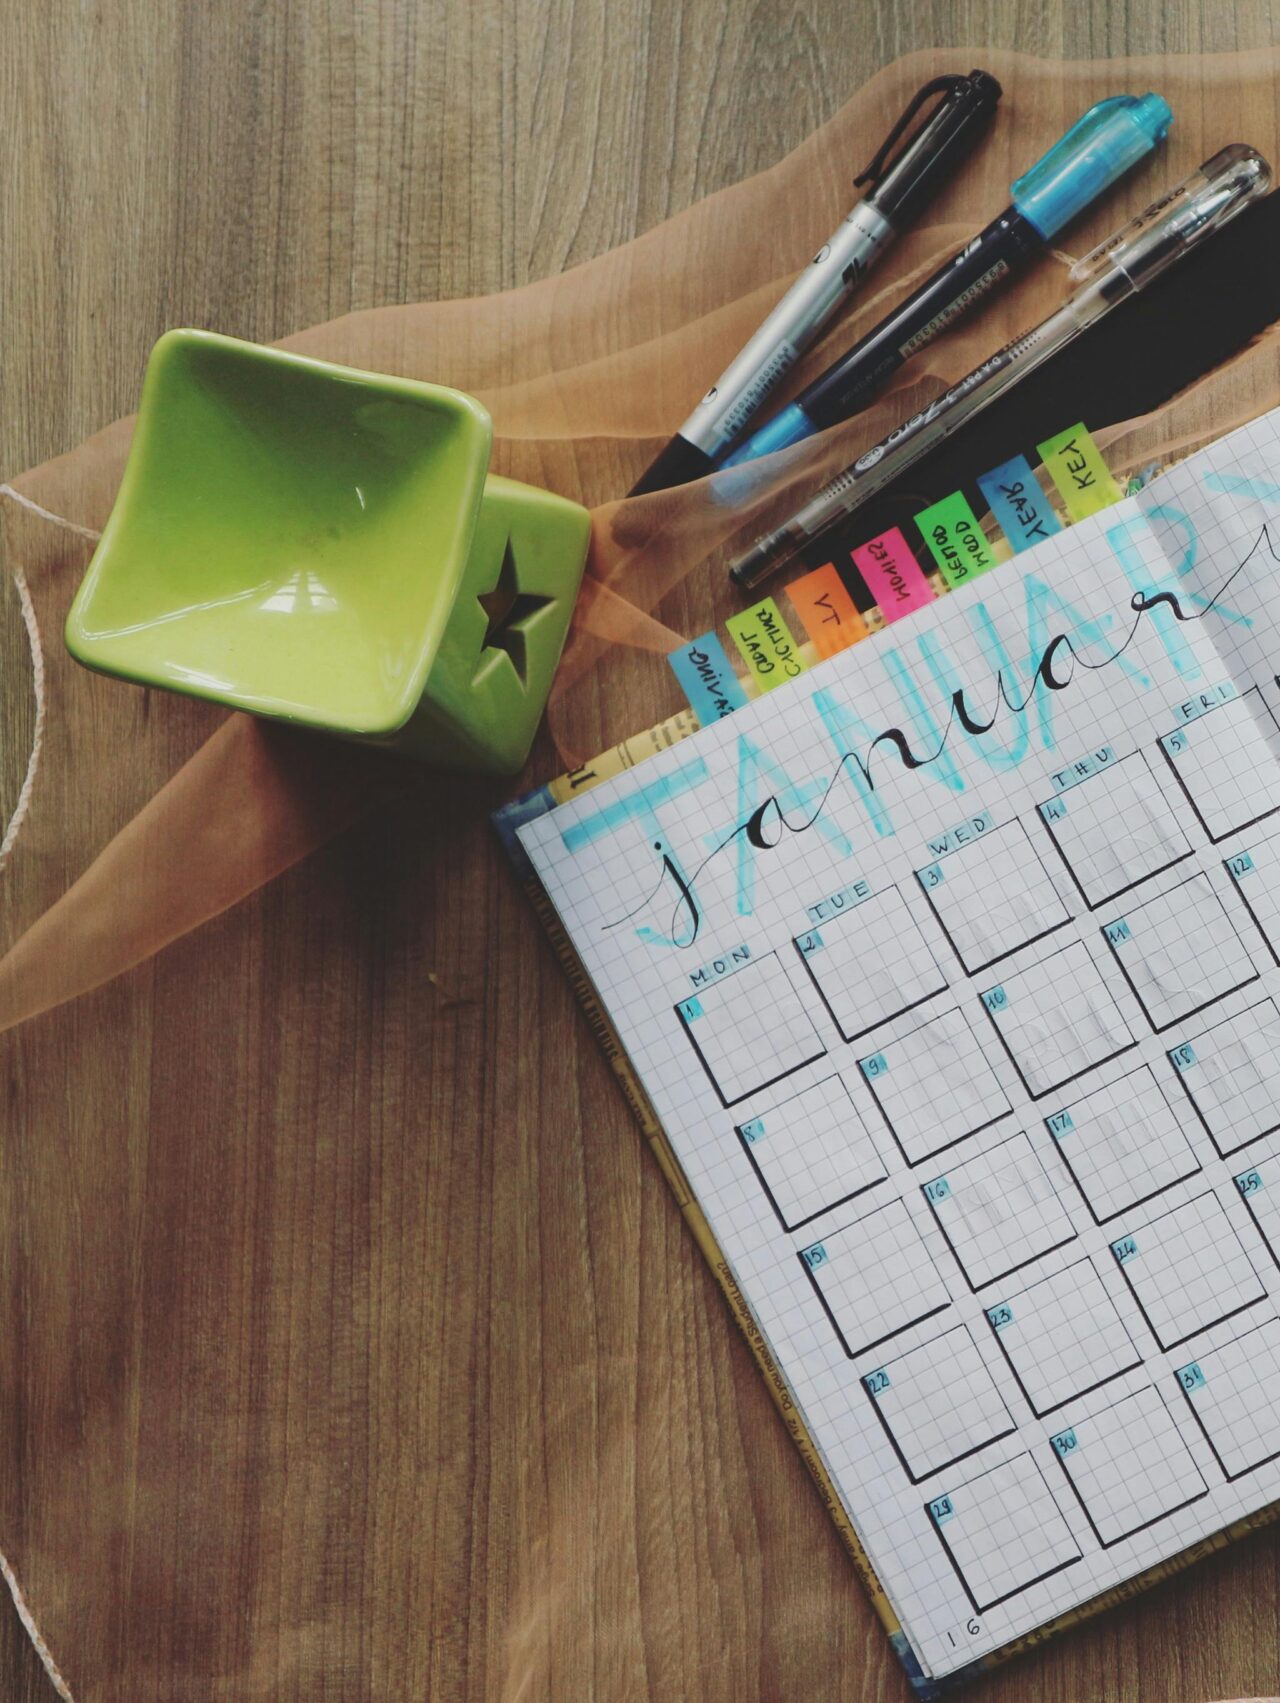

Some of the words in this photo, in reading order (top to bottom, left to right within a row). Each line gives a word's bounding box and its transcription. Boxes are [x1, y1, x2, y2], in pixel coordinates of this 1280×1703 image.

[1181, 686, 1228, 718] FRI
[1171, 736, 1182, 752] 5
[1051, 748, 1110, 788] THU
[1047, 805, 1060, 819] 4
[931, 819, 986, 854] WED
[1233, 858, 1250, 876] 12
[929, 871, 939, 887] 3
[808, 882, 867, 920] TUE
[1108, 927, 1126, 943] 11
[804, 937, 816, 952] 2
[689, 948, 750, 987] MON
[988, 992, 1005, 1010] 10
[685, 1004, 694, 1017] 1
[1174, 1048, 1192, 1066] 18
[869, 1059, 879, 1076] 9
[1051, 1114, 1067, 1132] 17
[743, 1126, 756, 1143] 8
[928, 1184, 945, 1200] 16
[804, 1251, 823, 1268] 15
[1116, 1243, 1135, 1261] 24
[868, 1373, 890, 1394] 22
[1184, 1369, 1201, 1388] 31
[1056, 1435, 1076, 1454] 30
[934, 1499, 952, 1517] 29
[947, 1618, 980, 1646] 16
